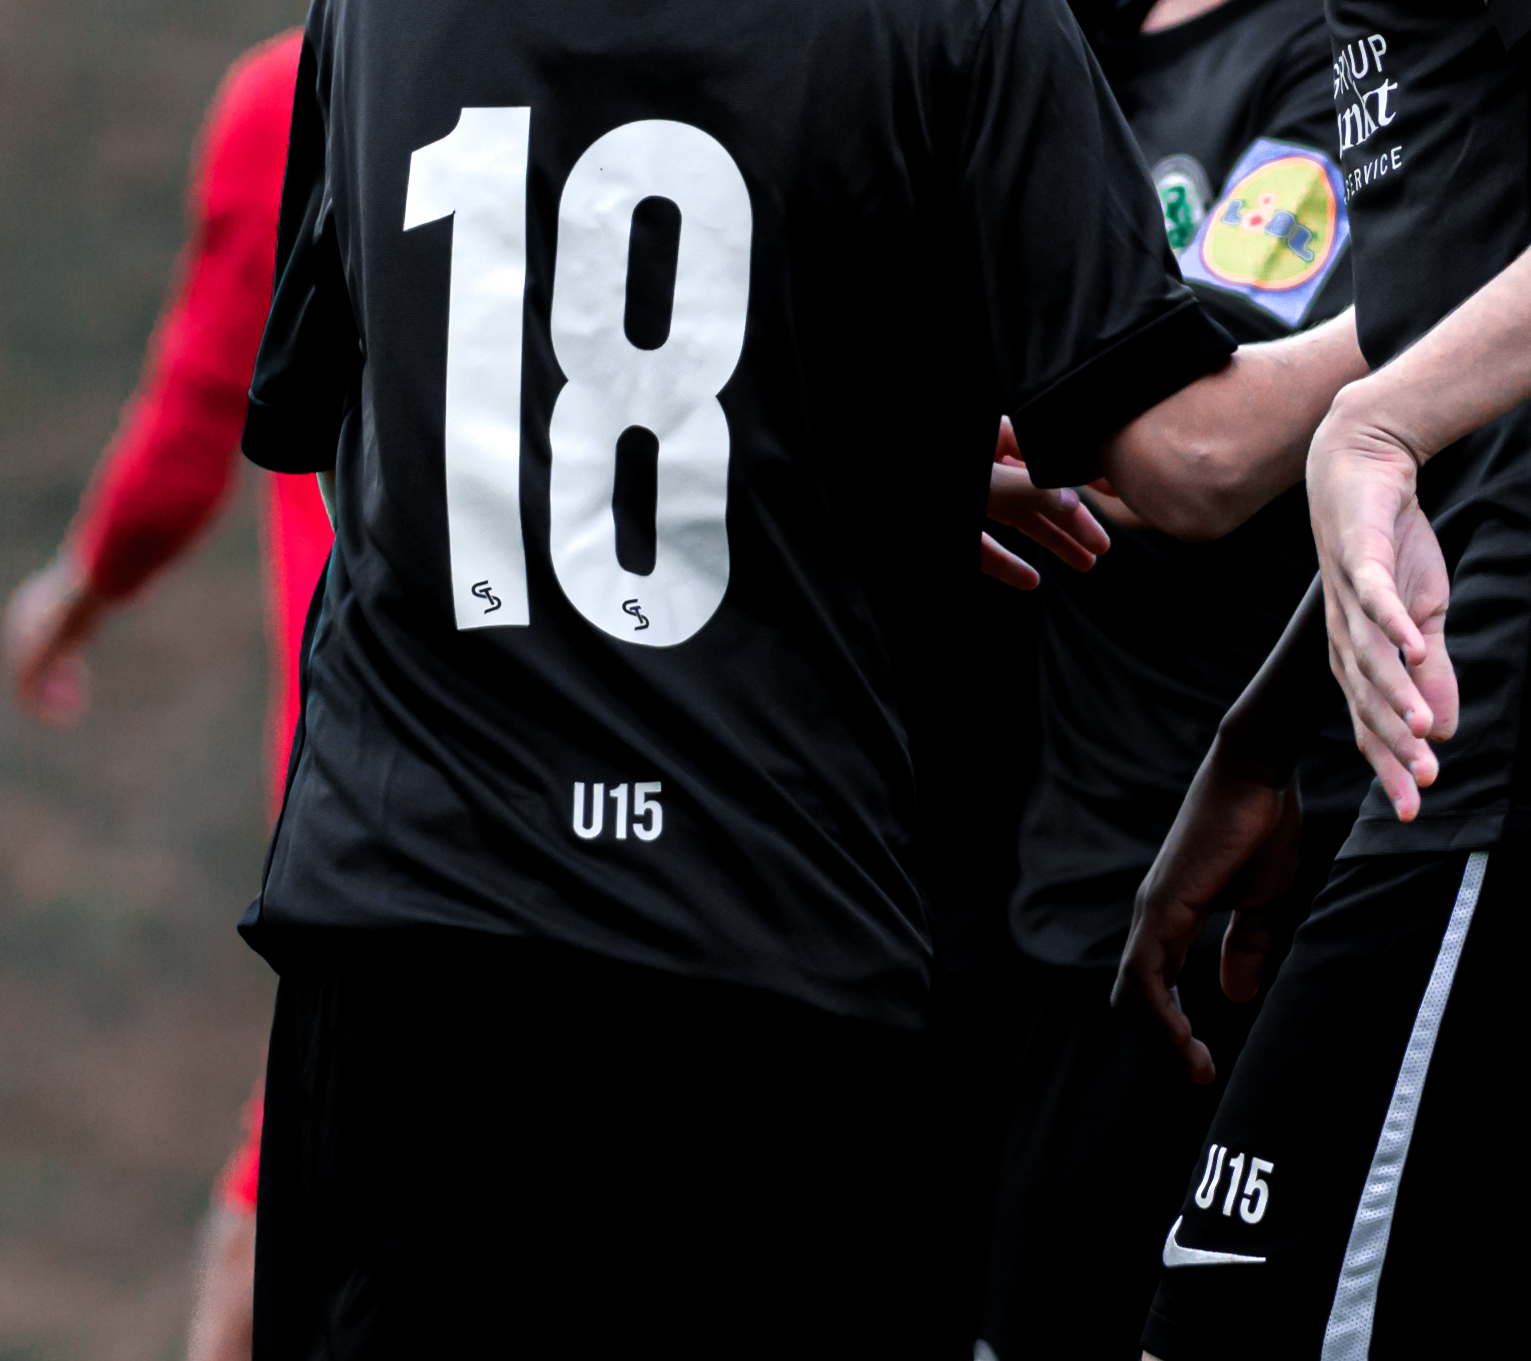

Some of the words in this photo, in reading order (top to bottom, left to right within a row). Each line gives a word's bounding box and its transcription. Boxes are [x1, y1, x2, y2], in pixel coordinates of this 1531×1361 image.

[403, 106, 753, 647] 18
[573, 781, 664, 841] U15
[1195, 1144, 1274, 1224] U15
